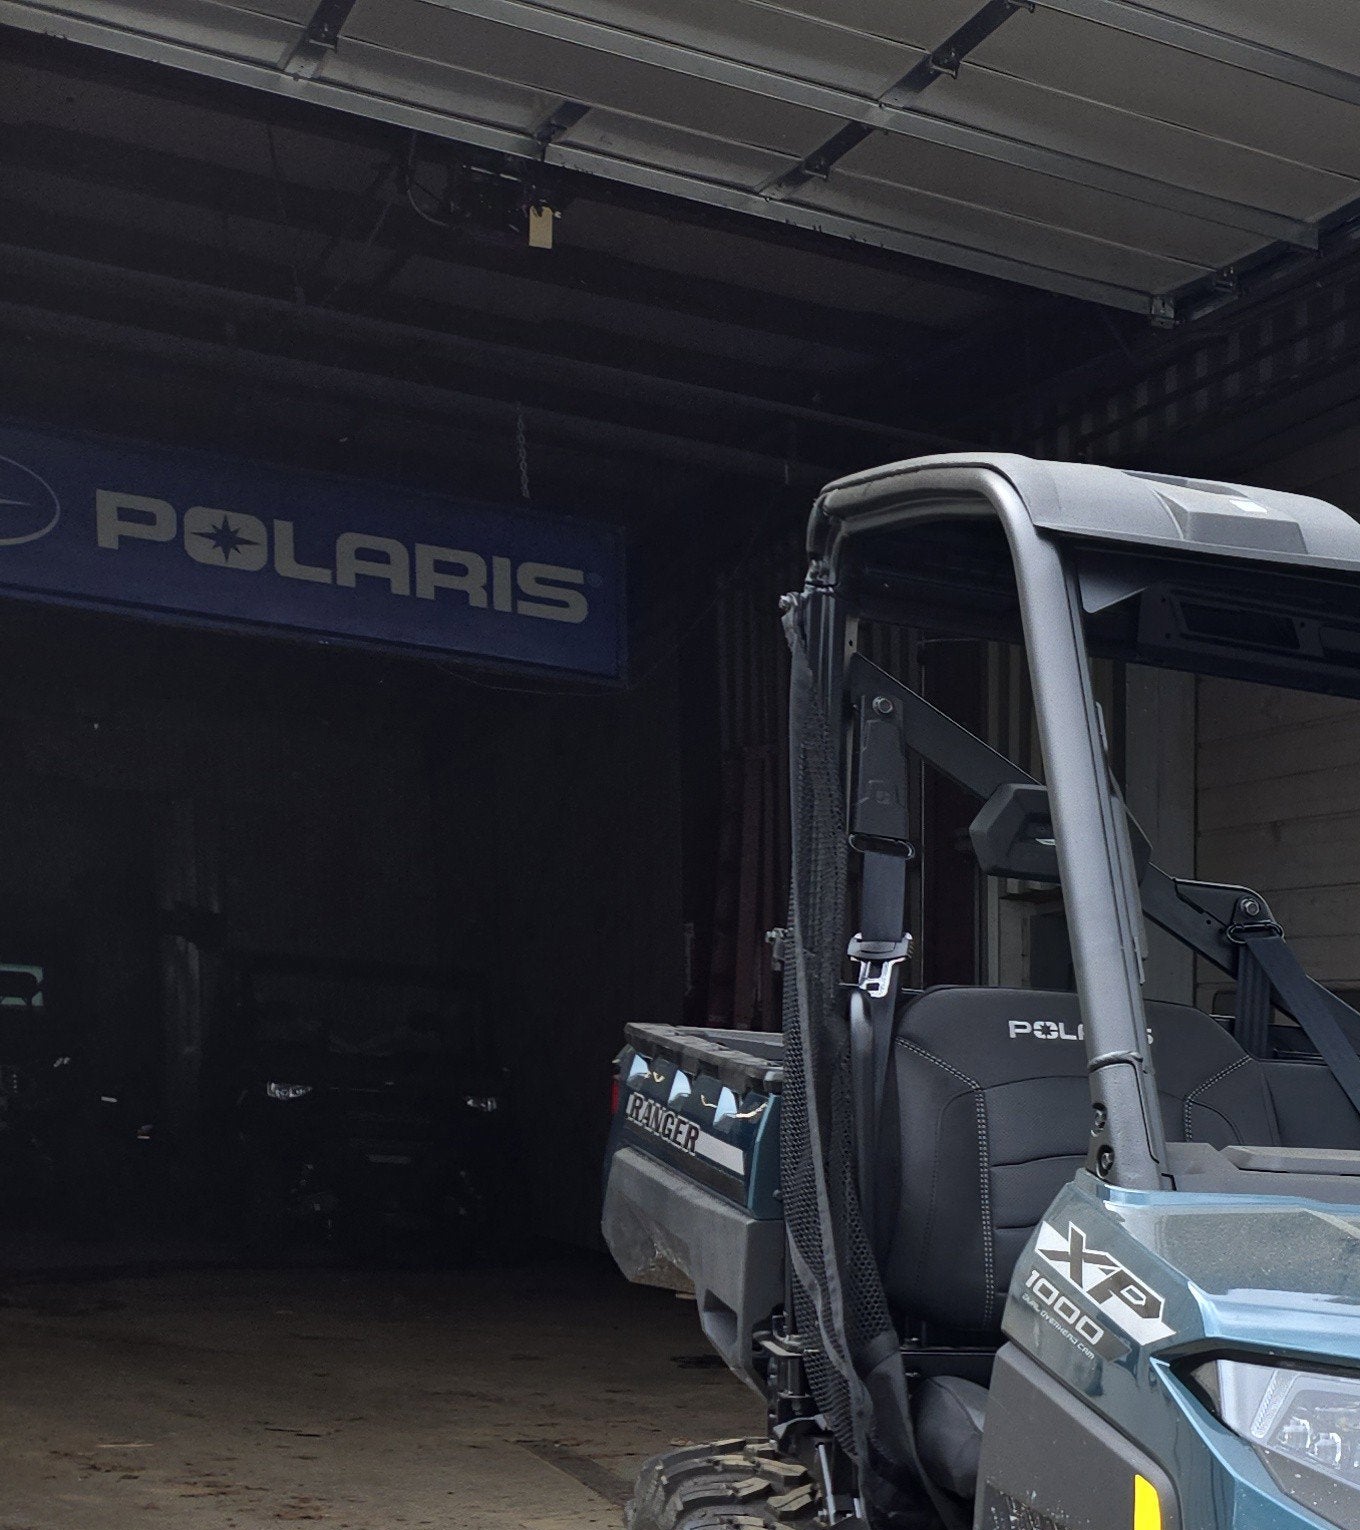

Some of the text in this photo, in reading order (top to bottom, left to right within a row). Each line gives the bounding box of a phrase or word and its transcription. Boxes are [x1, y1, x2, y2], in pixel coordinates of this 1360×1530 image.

[95, 488, 590, 625] POLARIS
[625, 1091, 701, 1157] RANGER
[1025, 1269, 1105, 1346] 1000
[1035, 1220, 1166, 1323] XP
